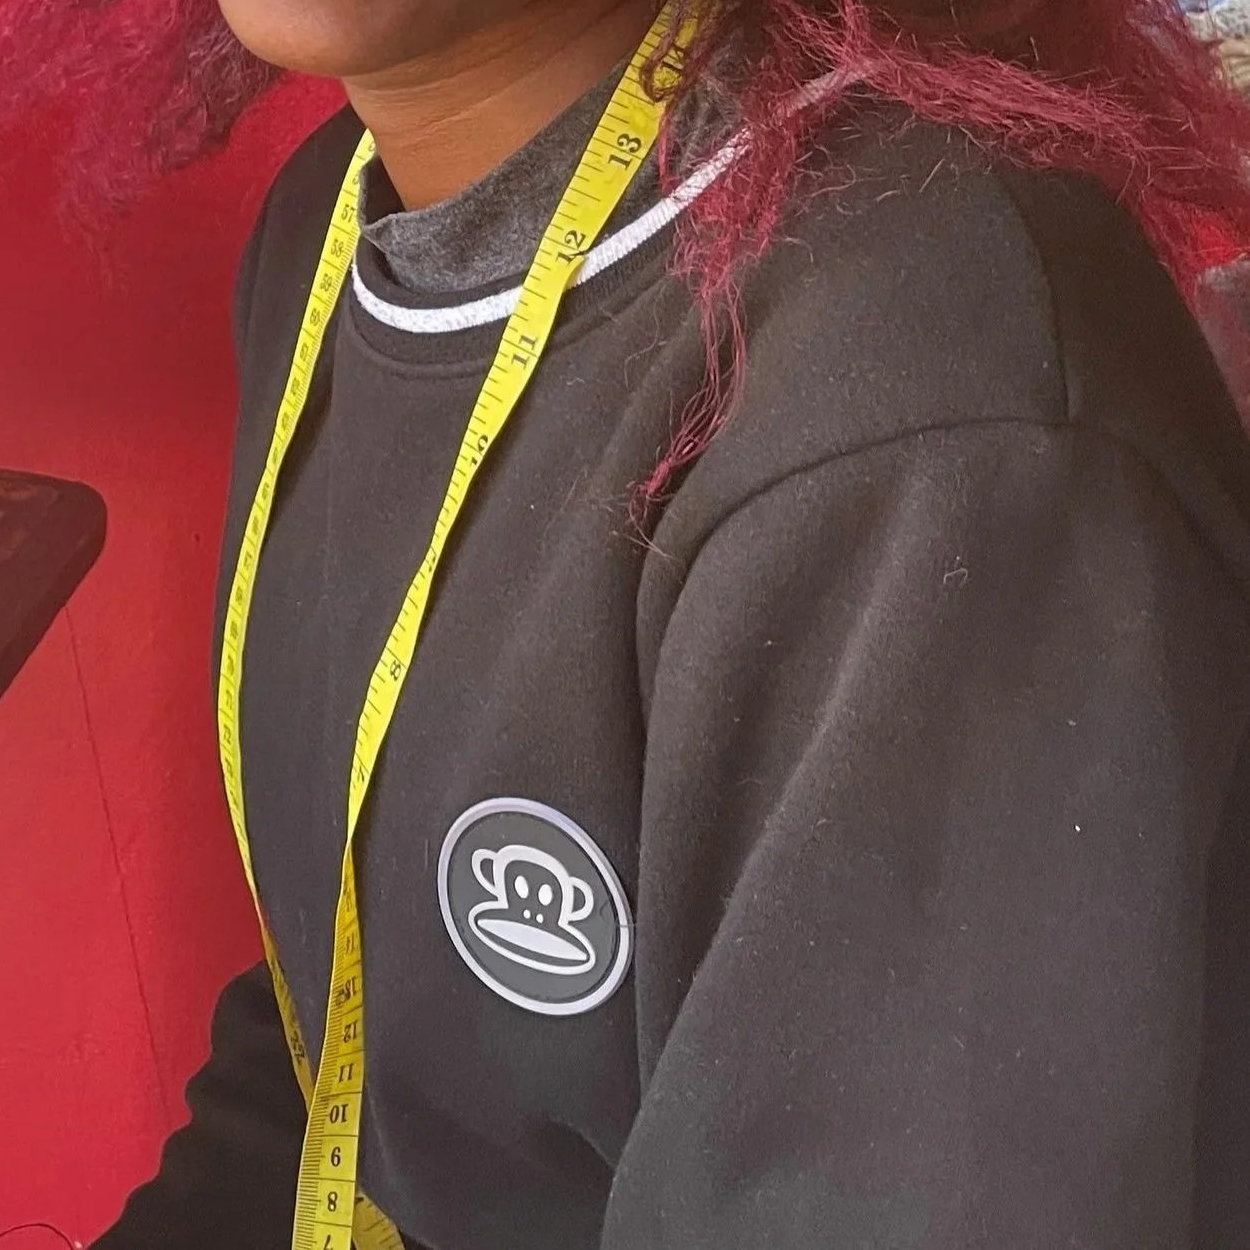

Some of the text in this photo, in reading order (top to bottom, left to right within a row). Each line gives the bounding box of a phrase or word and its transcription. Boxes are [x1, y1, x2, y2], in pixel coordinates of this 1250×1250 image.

[608, 133, 642, 171] 13
[340, 204, 355, 223] 57
[330, 239, 345, 258] 58
[556, 229, 587, 266] 12
[511, 333, 539, 370] 11
[469, 434, 489, 467] 10
[389, 660, 401, 681] 8
[343, 1019, 358, 1043] 12
[338, 1062, 354, 1083] 11
[329, 1103, 349, 1124] 10
[327, 1191, 338, 1212] 8
